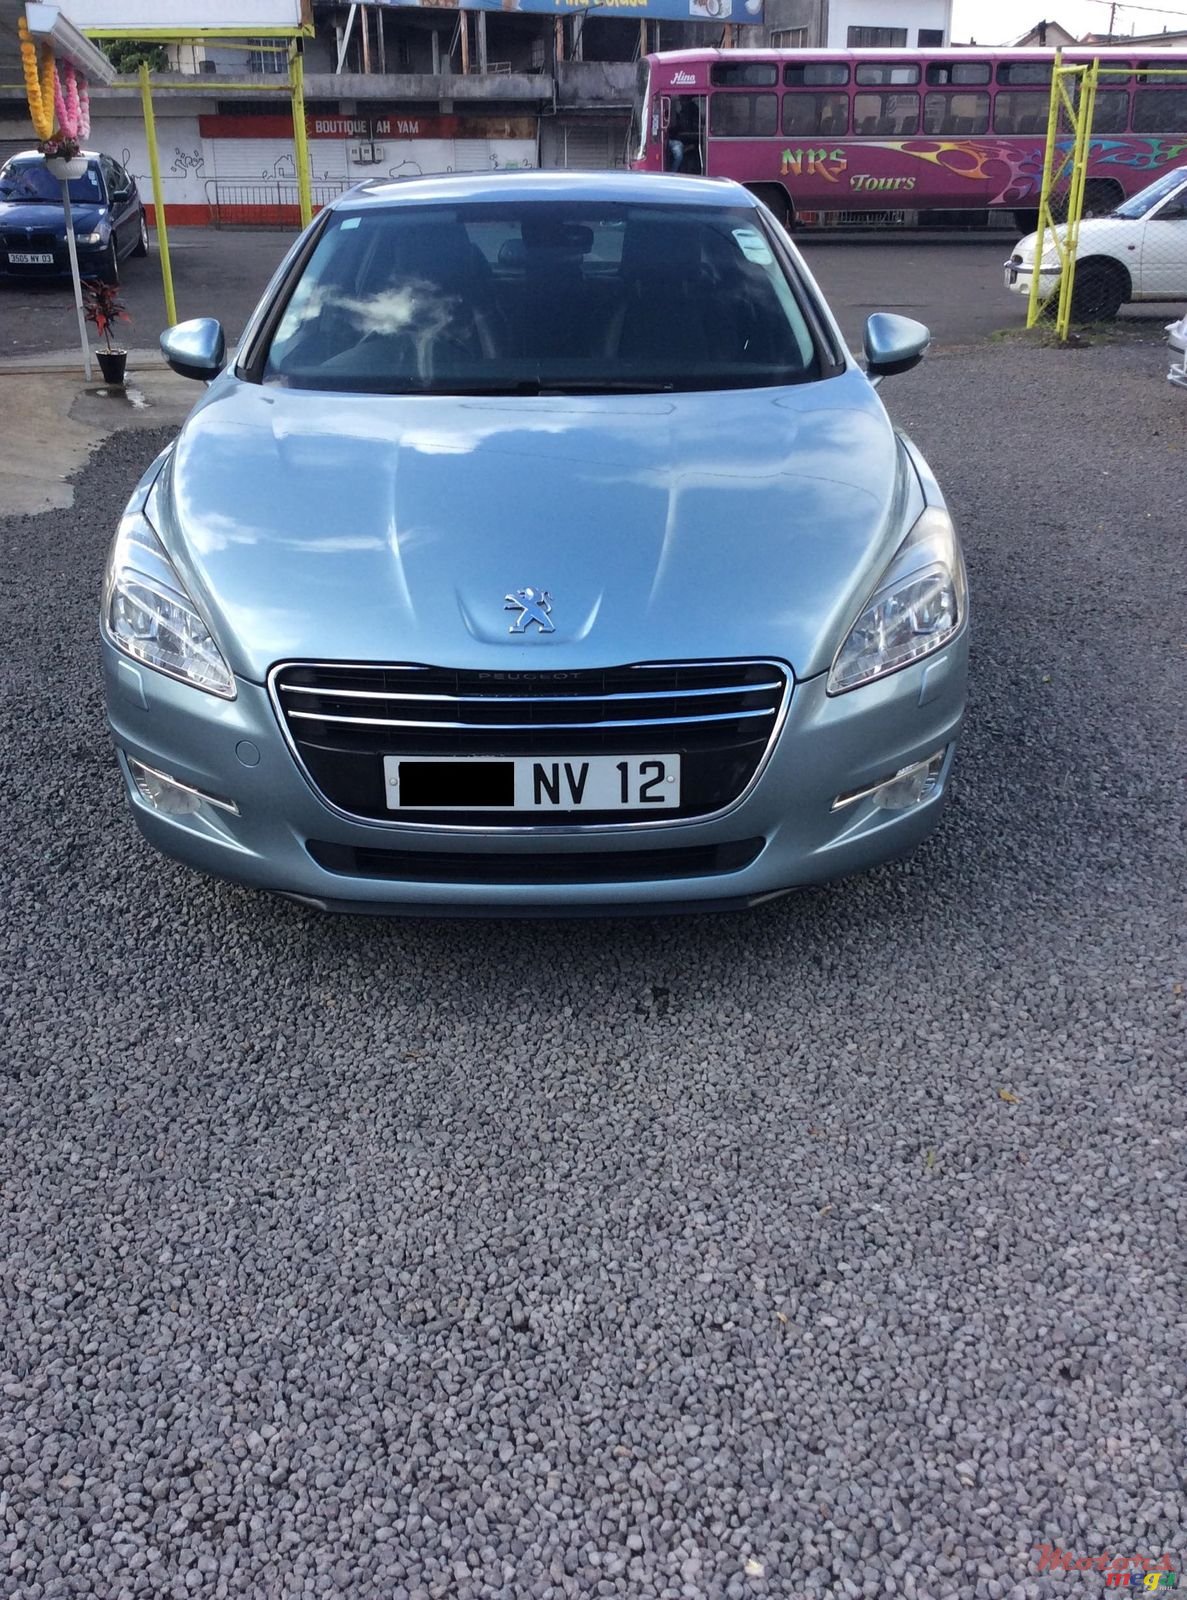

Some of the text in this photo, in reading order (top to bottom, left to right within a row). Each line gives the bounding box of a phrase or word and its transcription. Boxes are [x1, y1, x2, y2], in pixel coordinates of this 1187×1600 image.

[670, 70, 697, 84] Hino
[315, 120, 420, 135] BOUTIQUE AH YAM
[780, 148, 848, 183] NRS
[850, 174, 917, 192] Tours
[478, 671, 583, 681] PEUGEOT
[533, 760, 665, 805] NV 12
